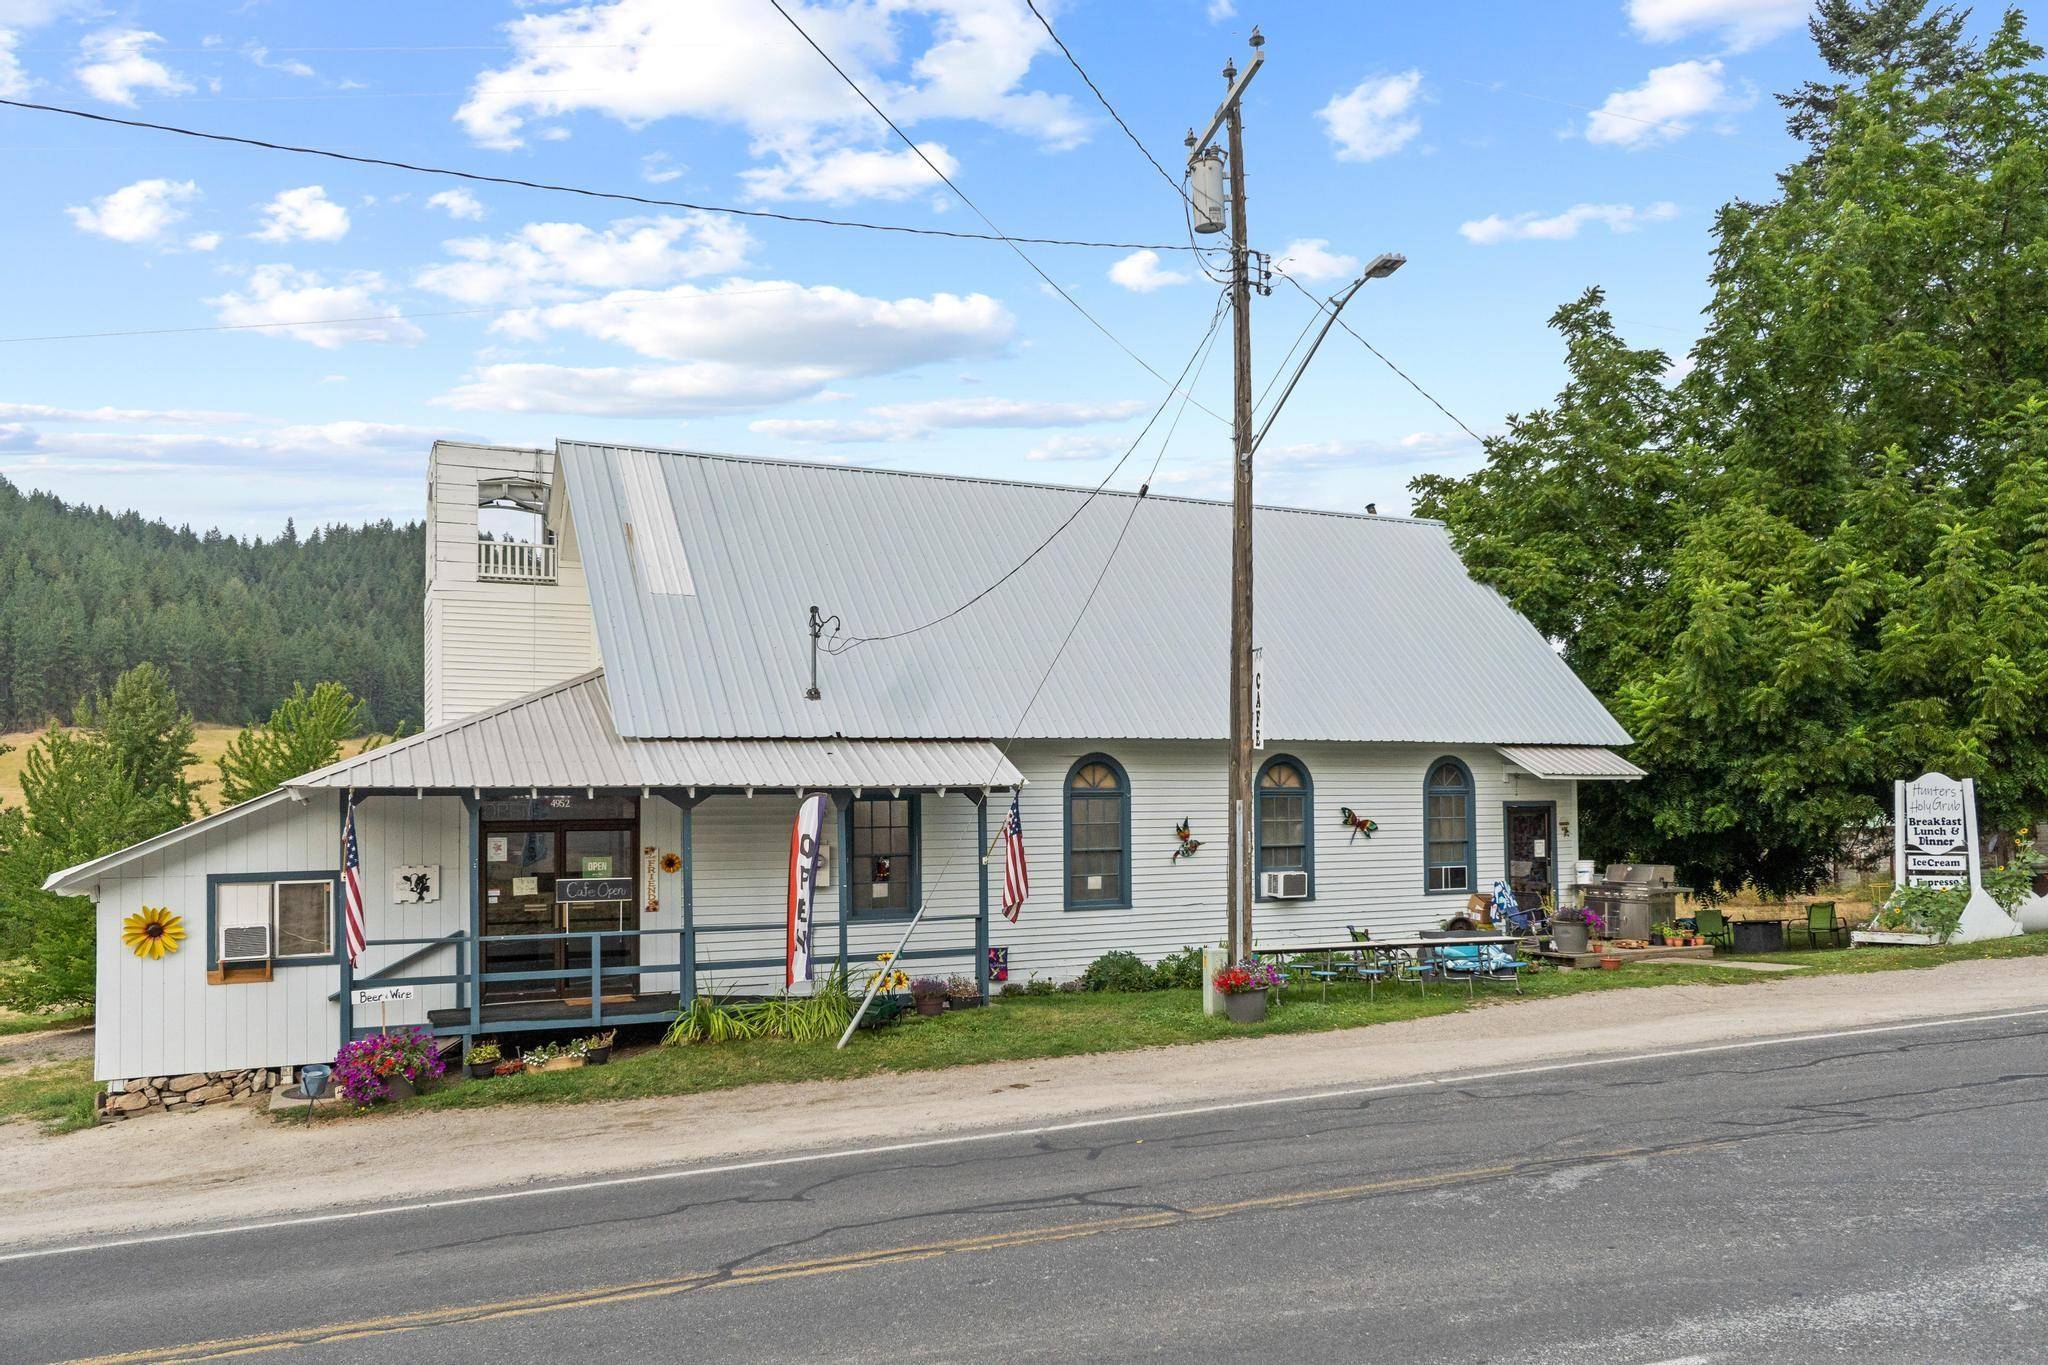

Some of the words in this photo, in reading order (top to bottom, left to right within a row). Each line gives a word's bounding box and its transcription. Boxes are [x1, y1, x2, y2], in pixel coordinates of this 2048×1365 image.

[1913, 784, 1956, 797] Hunters
[550, 799, 570, 808] 4952
[1909, 817, 1962, 826] Breakfast
[1914, 827, 1946, 835] Lunch
[1951, 827, 1959, 835] &
[1919, 837, 1954, 846] Dinner
[587, 861, 607, 871] OPEN
[567, 882, 596, 898] Cafe
[598, 882, 626, 898] Open
[360, 991, 382, 1003] Beer
